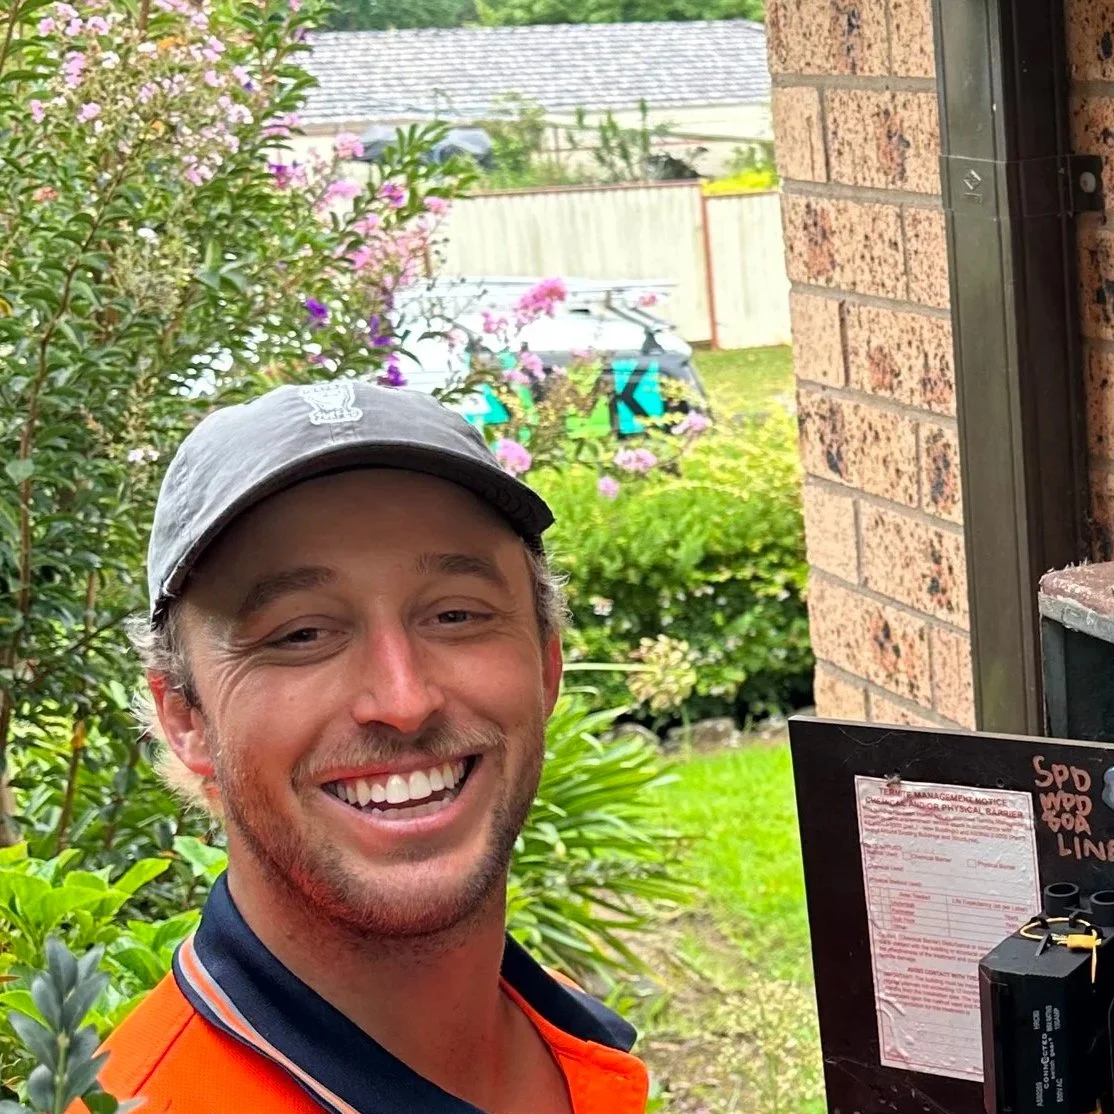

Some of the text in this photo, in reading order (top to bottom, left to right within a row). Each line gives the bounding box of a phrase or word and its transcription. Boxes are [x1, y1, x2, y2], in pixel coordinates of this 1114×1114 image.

[1033, 755, 1091, 792] SPD
[975, 797, 1007, 806] NOTICE
[941, 804, 984, 815] PHYSICAL
[986, 808, 1023, 818] BARRIER
